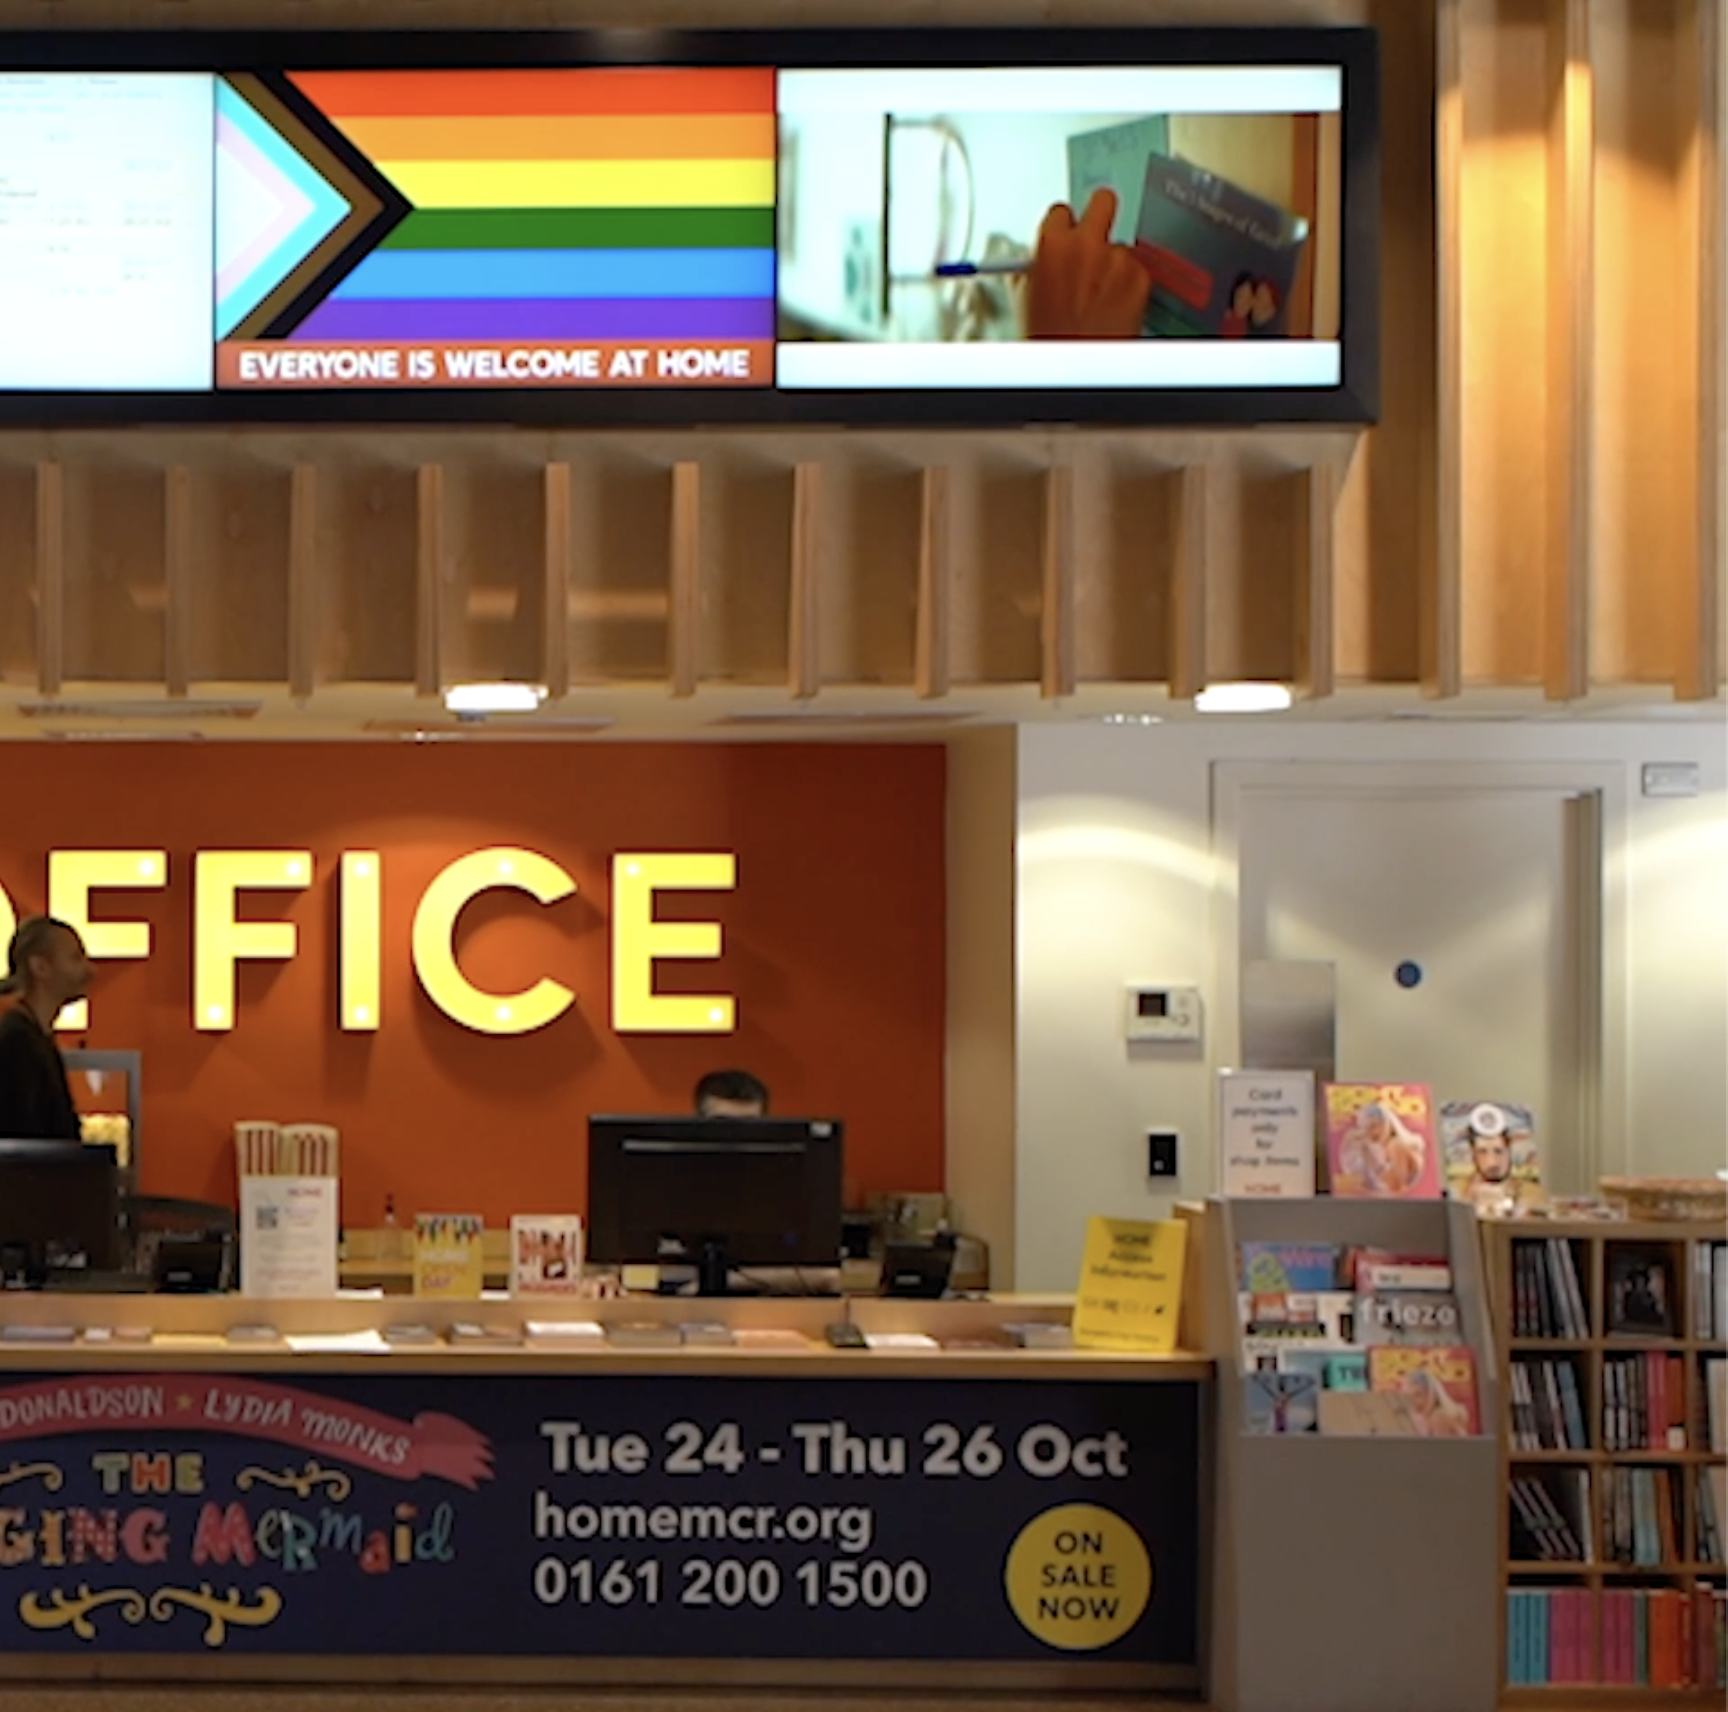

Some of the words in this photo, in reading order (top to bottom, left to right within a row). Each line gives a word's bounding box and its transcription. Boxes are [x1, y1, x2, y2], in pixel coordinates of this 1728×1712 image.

[239, 350, 399, 379] EVERYONE
[408, 350, 435, 377] IS
[448, 349, 599, 379] WELCOME
[609, 349, 649, 376] AT
[658, 348, 750, 377] HOME
[1249, 1088, 1282, 1100] Card
[1232, 1105, 1298, 1118] payments
[1251, 1121, 1278, 1135] only
[1256, 1136, 1273, 1150] for
[1230, 1154, 1260, 1168] shop
[203, 1387, 292, 1427] LYDIA
[300, 1408, 412, 1466] MONKS
[540, 1420, 650, 1474] Tue
[665, 1423, 744, 1474] 24
[791, 1421, 908, 1474] Thu
[922, 1424, 1003, 1475] 26
[1017, 1424, 1129, 1475] Oct
[92, 1452, 204, 1494] THE
[534, 1491, 874, 1552] homemcr.org
[1055, 1531, 1103, 1553] ON
[534, 1558, 660, 1605] 0161
[681, 1558, 781, 1605] 200
[795, 1558, 928, 1606] 1500
[1040, 1564, 1117, 1588] SALE
[1038, 1597, 1120, 1621] NOW
